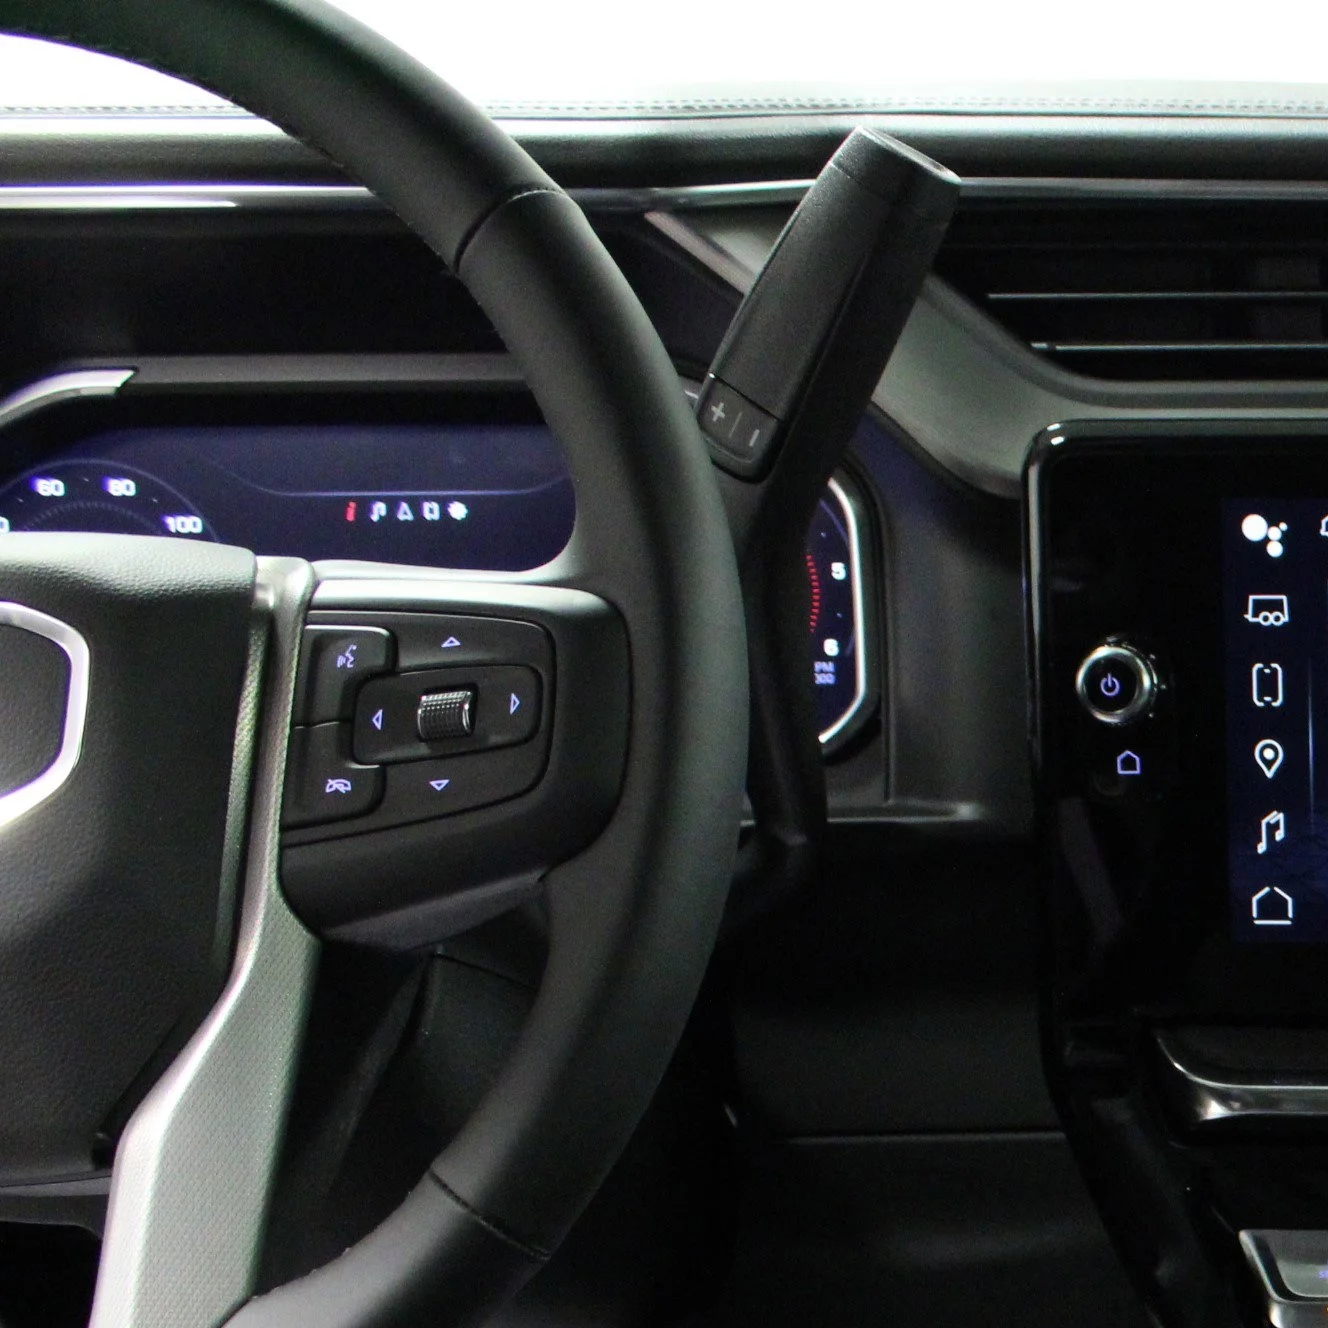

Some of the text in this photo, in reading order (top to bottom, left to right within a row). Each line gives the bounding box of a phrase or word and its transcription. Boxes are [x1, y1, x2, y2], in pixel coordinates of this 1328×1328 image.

[34, 477, 66, 497] 60
[104, 477, 137, 497] 80
[163, 515, 203, 534] 100
[831, 561, 847, 580] 5
